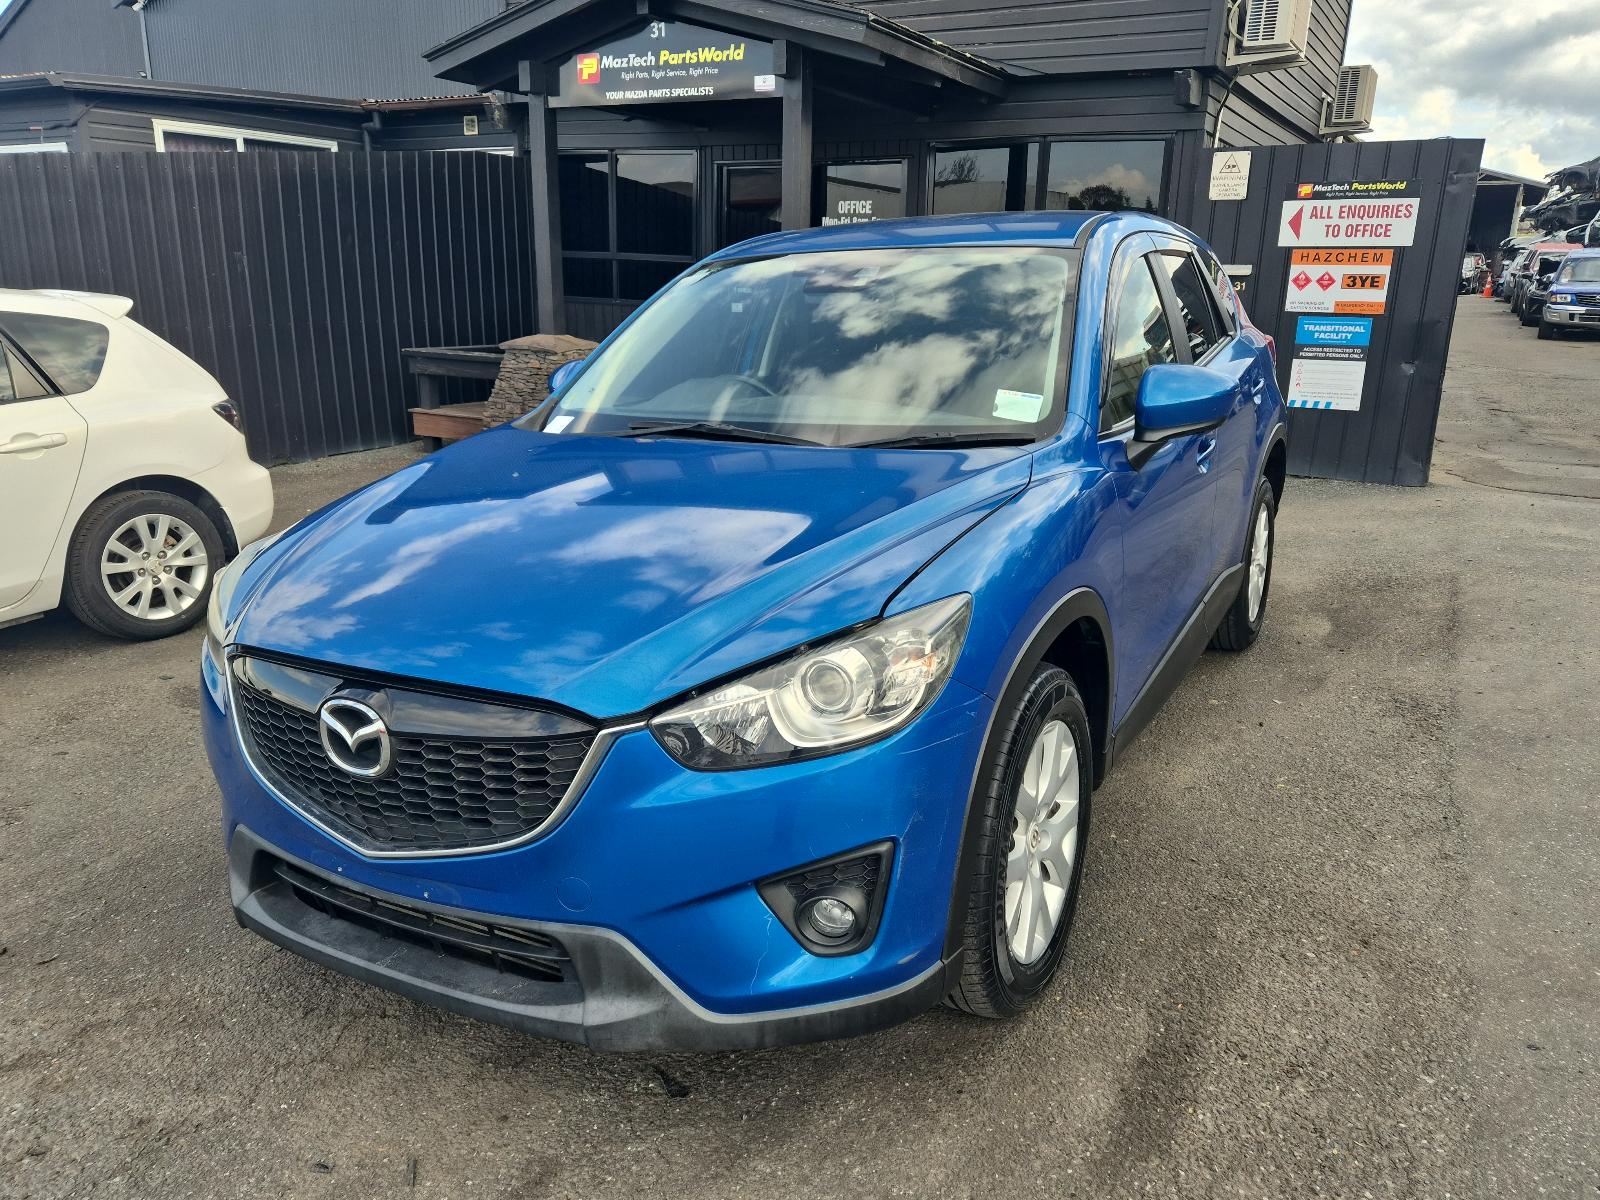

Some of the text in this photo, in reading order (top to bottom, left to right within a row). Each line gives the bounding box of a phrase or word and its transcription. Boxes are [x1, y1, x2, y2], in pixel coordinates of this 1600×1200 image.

[650, 22, 665, 38] 31
[601, 43, 745, 69] MazTech PartsWorld
[622, 66, 719, 80] Right Parts, Right Service, Right Price
[606, 86, 714, 100] YOUR MAZDA PARTS SPECIALISTS
[1314, 181, 1407, 191] MazTech PartsWorld
[838, 200, 873, 214] OFFICE
[1309, 203, 1414, 220] ALL ENQUIRIES
[1324, 223, 1393, 238] TO OFFICE
[1300, 252, 1384, 263] HAZCHEM
[1234, 281, 1246, 291] 31
[1346, 275, 1381, 288] 3YE
[1303, 324, 1366, 333] TRANSITIONAL
[1314, 332, 1353, 340] FACILITY
